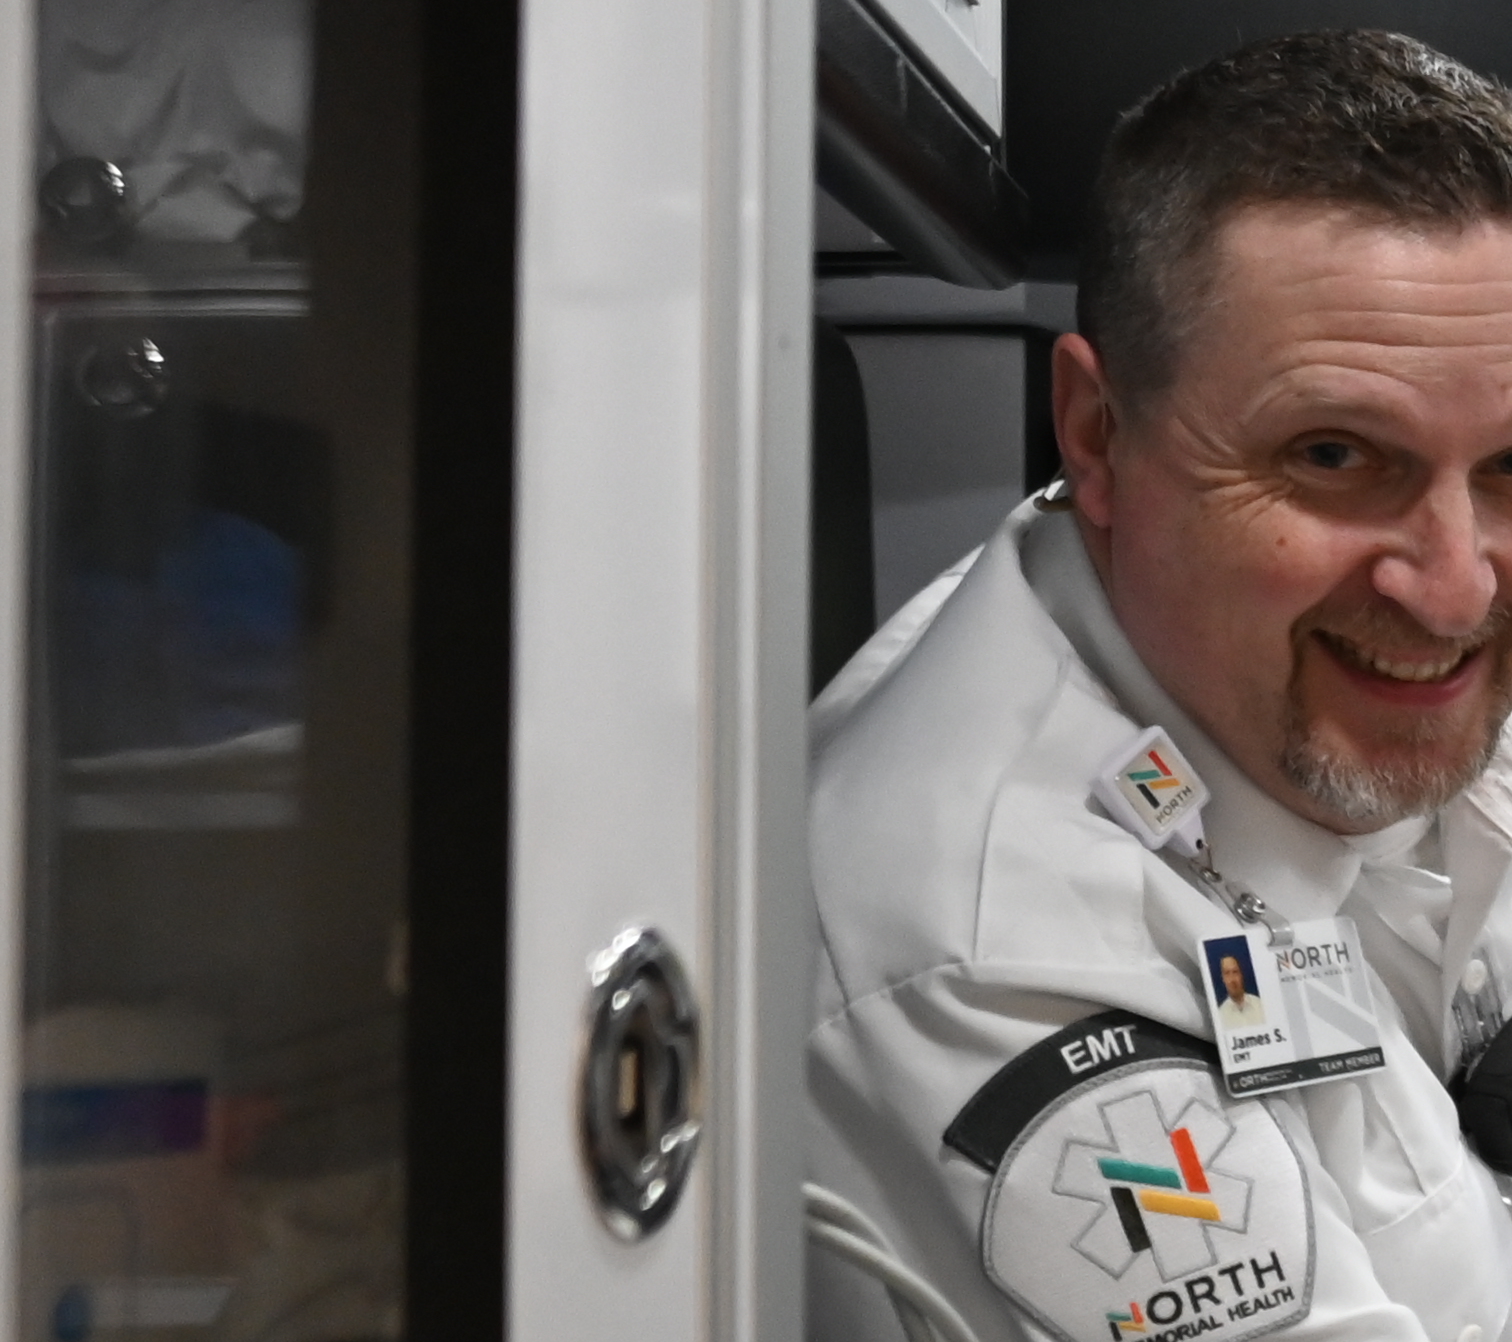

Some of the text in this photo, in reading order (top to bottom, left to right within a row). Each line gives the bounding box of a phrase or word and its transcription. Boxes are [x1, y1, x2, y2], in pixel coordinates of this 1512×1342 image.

[1275, 942, 1351, 973] NORTH
[1060, 1025, 1137, 1074] EMT
[1231, 1028, 1288, 1051] James S.
[1318, 1052, 1381, 1074] TEAM MEMBER
[1227, 1286, 1296, 1323] HEALTH
